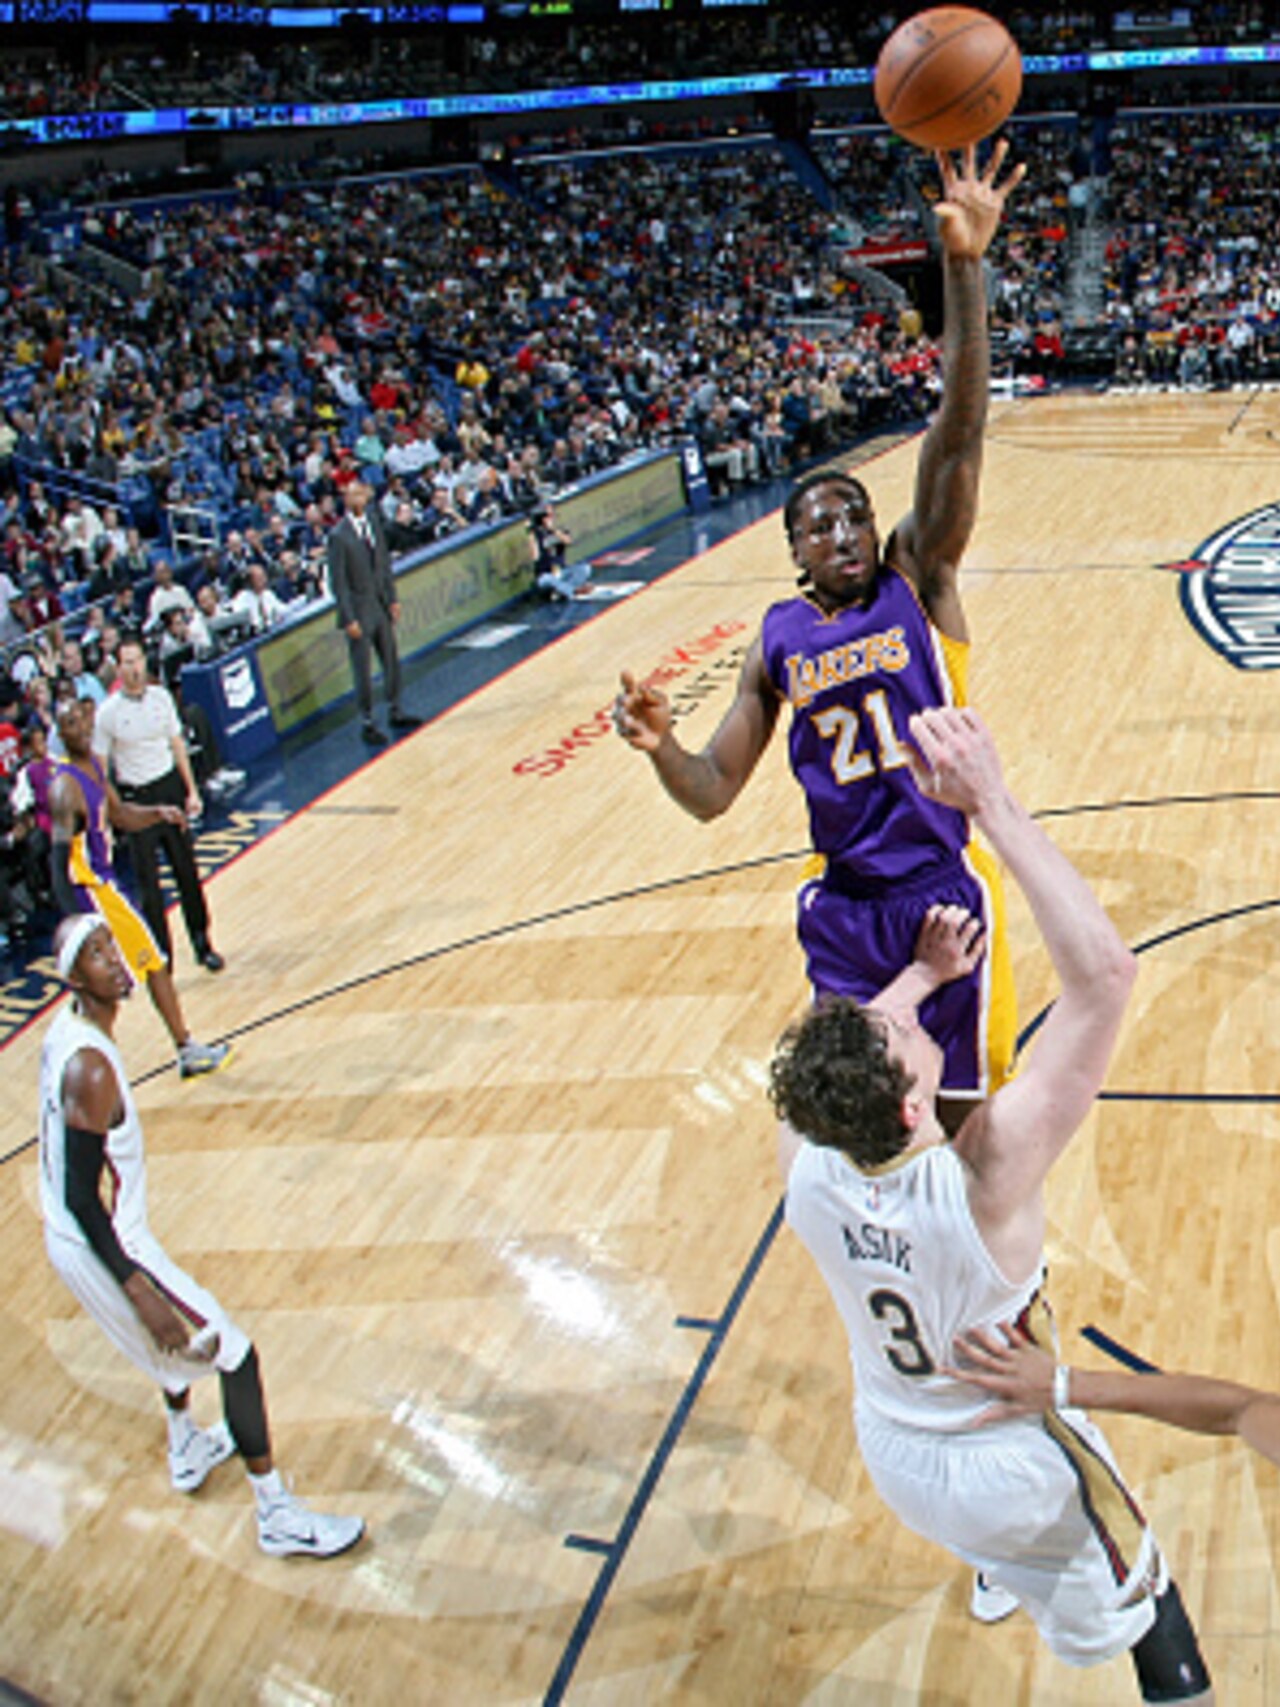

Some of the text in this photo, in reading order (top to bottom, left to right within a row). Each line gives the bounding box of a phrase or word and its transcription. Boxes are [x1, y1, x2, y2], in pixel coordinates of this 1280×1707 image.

[785, 627, 910, 708] LAKERS
[810, 688, 911, 785] 21
[842, 1223, 914, 1273] ASIK
[867, 1288, 936, 1376] 3
